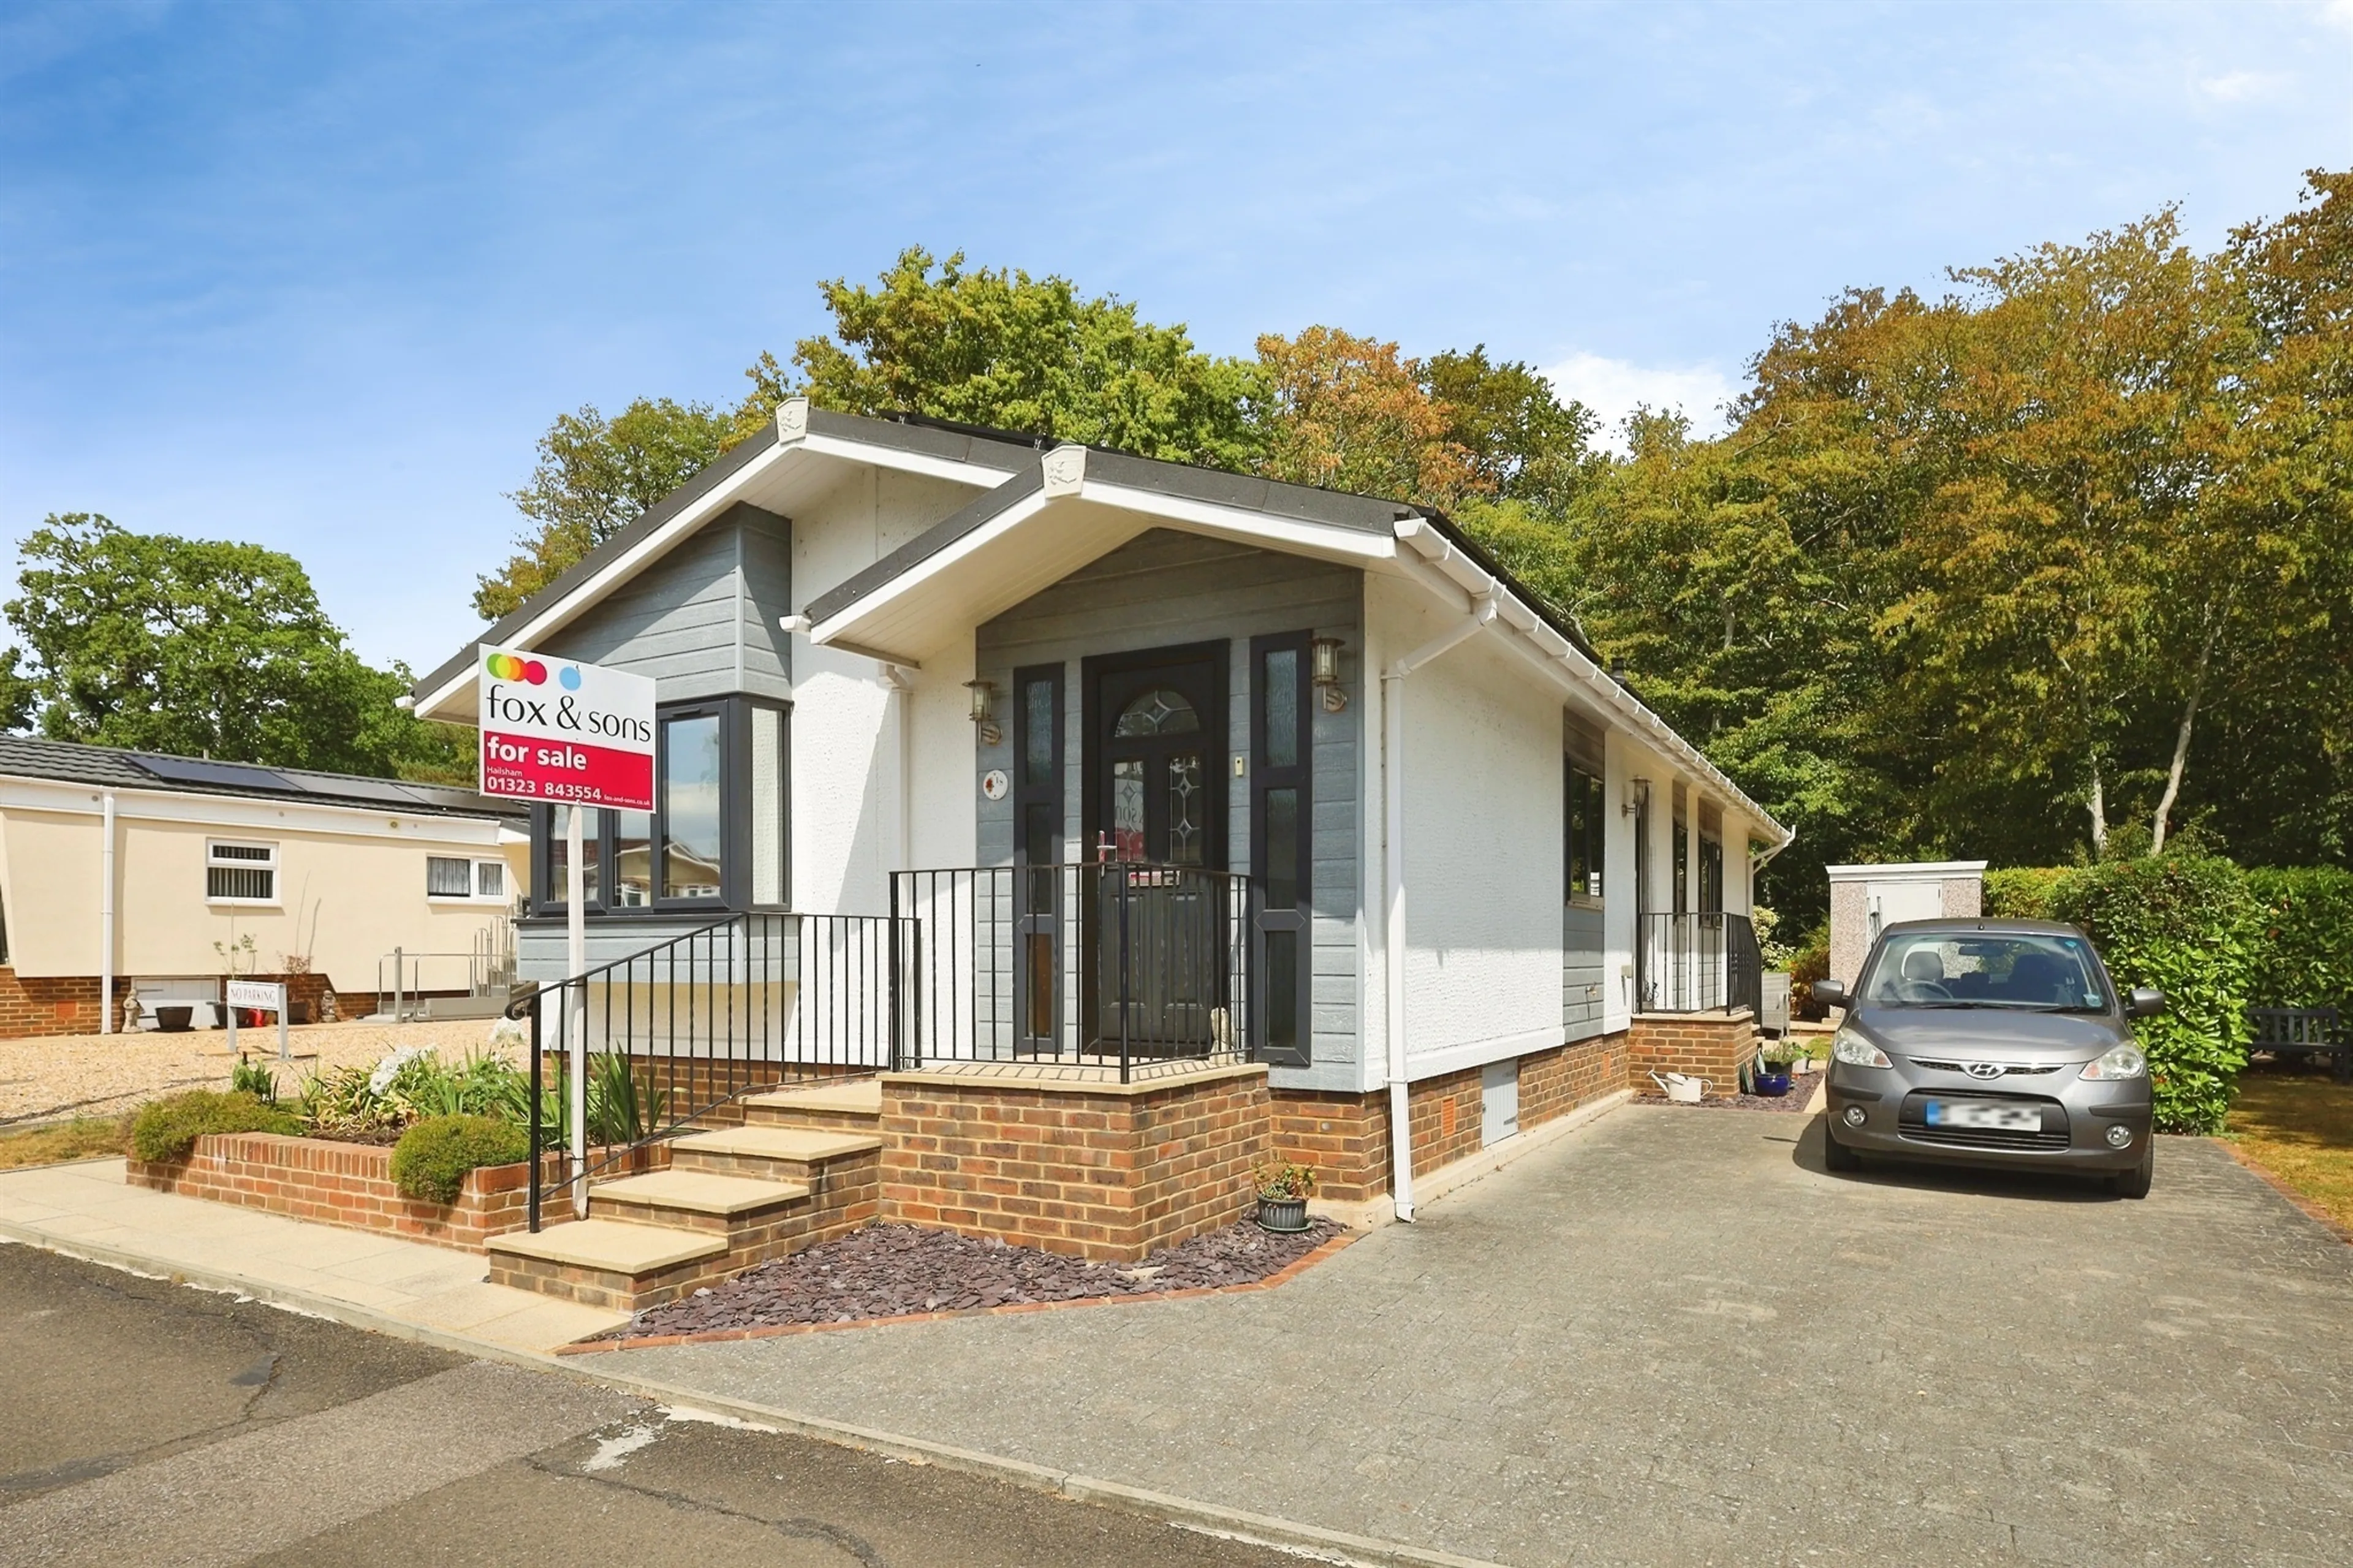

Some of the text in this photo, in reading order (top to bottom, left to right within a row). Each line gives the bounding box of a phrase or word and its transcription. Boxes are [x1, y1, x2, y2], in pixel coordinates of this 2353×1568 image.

[487, 684, 651, 743] fox & sons
[487, 736, 587, 770] for sale
[487, 766, 522, 777] Hailsham
[487, 776, 536, 793] 01323
[544, 782, 602, 800] 843554
[231, 988, 275, 1003] NO PARKING
